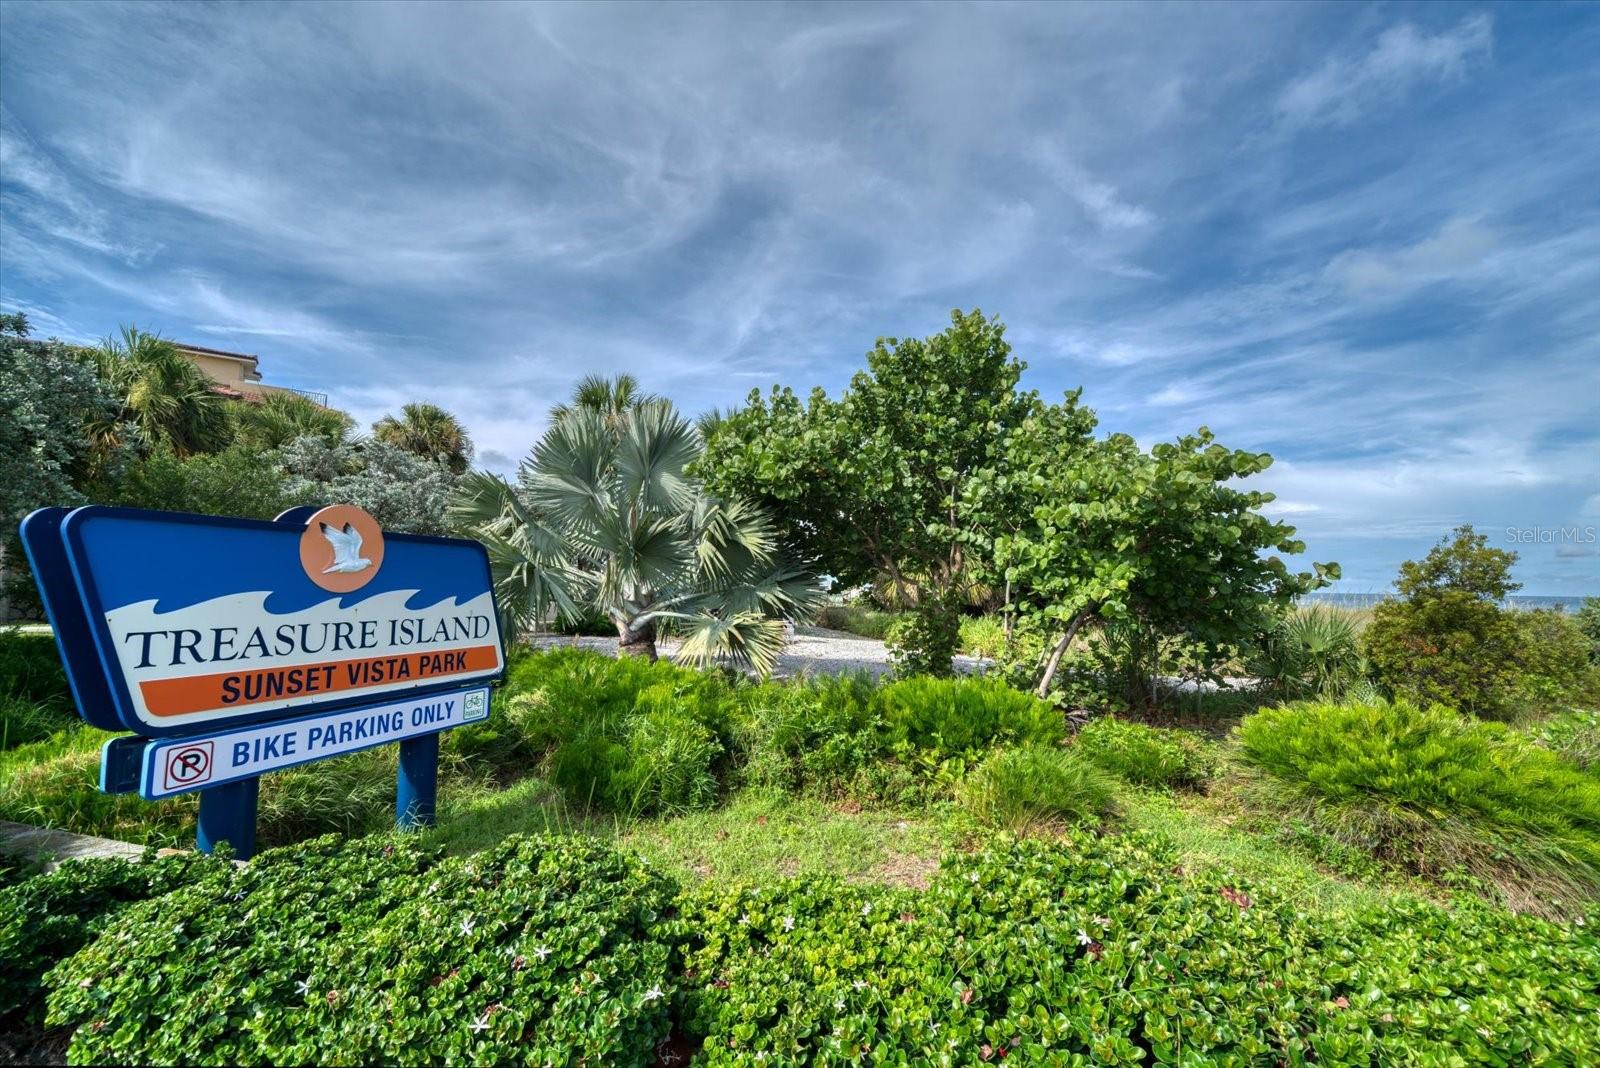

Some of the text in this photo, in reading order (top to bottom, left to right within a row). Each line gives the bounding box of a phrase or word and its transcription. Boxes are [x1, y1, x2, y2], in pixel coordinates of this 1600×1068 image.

[124, 615, 490, 669] TREASURE ISLAND
[221, 651, 467, 704] SUNSET VISTA PARK
[232, 700, 455, 768] BIKE PARKING ONLY
[181, 753, 201, 777] P
